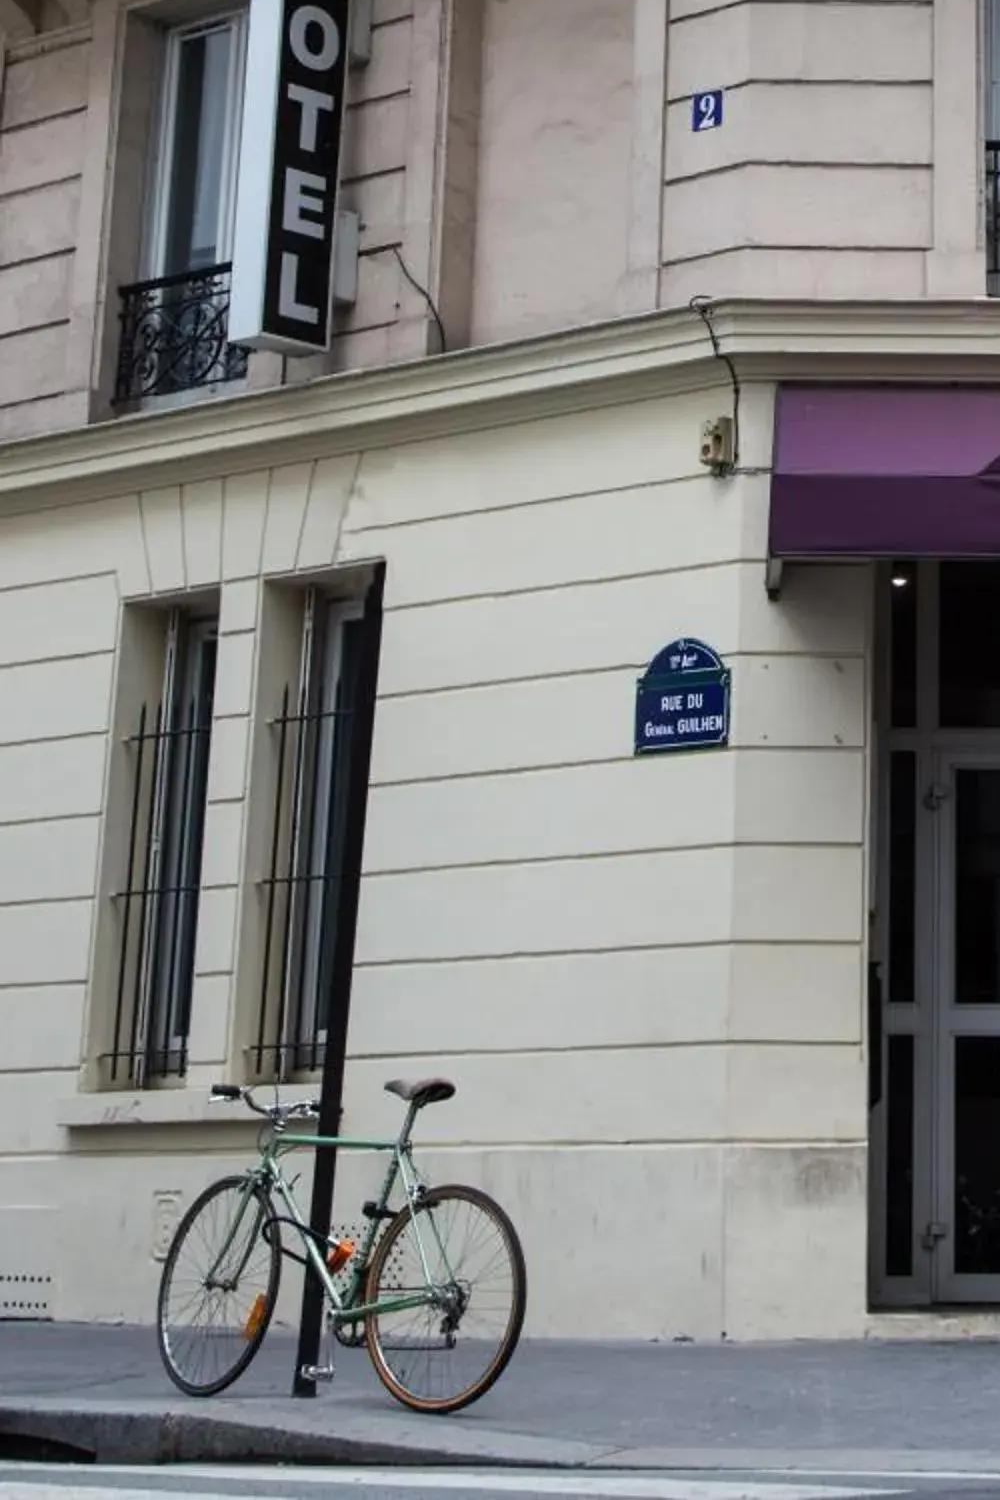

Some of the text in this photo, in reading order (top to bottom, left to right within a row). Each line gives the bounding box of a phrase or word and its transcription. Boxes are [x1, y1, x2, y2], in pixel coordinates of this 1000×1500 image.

[699, 95, 715, 128] 2
[661, 693, 703, 712] RUE DU
